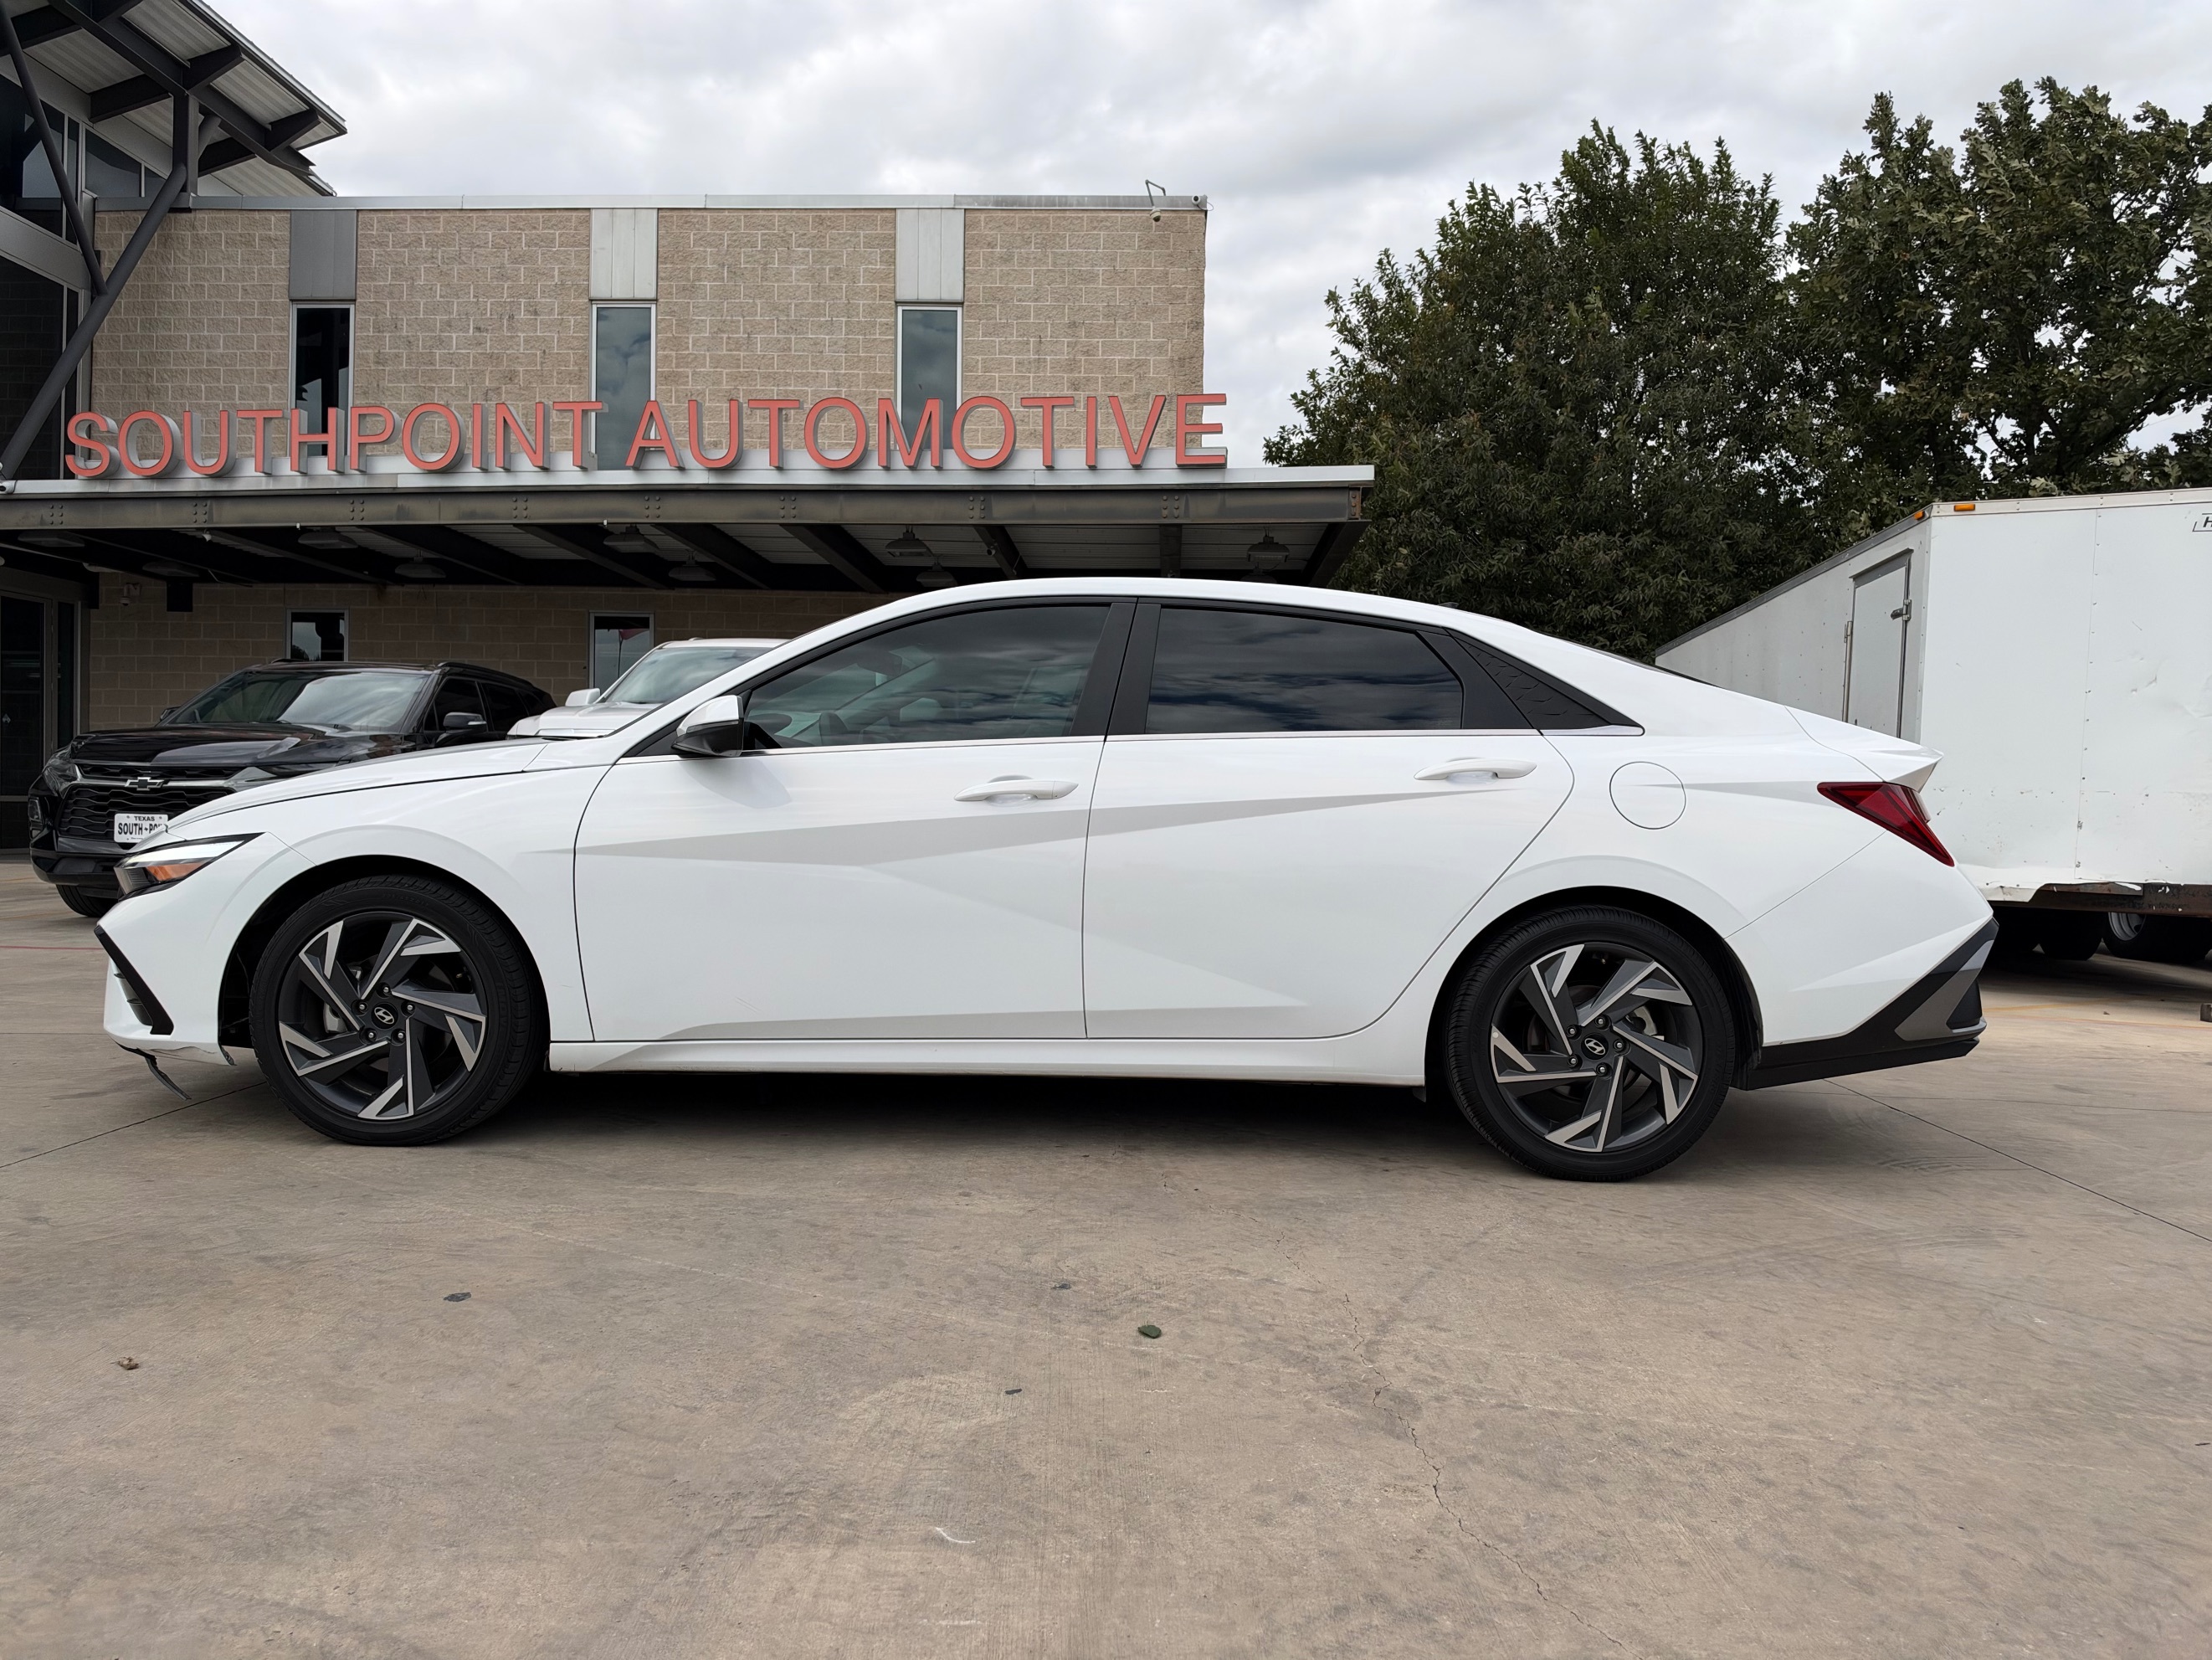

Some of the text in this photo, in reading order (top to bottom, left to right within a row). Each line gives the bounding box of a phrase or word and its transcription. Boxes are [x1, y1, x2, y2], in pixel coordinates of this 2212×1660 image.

[65, 393, 1227, 478] SOUTHPOINT AUTOMOTIVE
[117, 822, 143, 835] SOUTH
